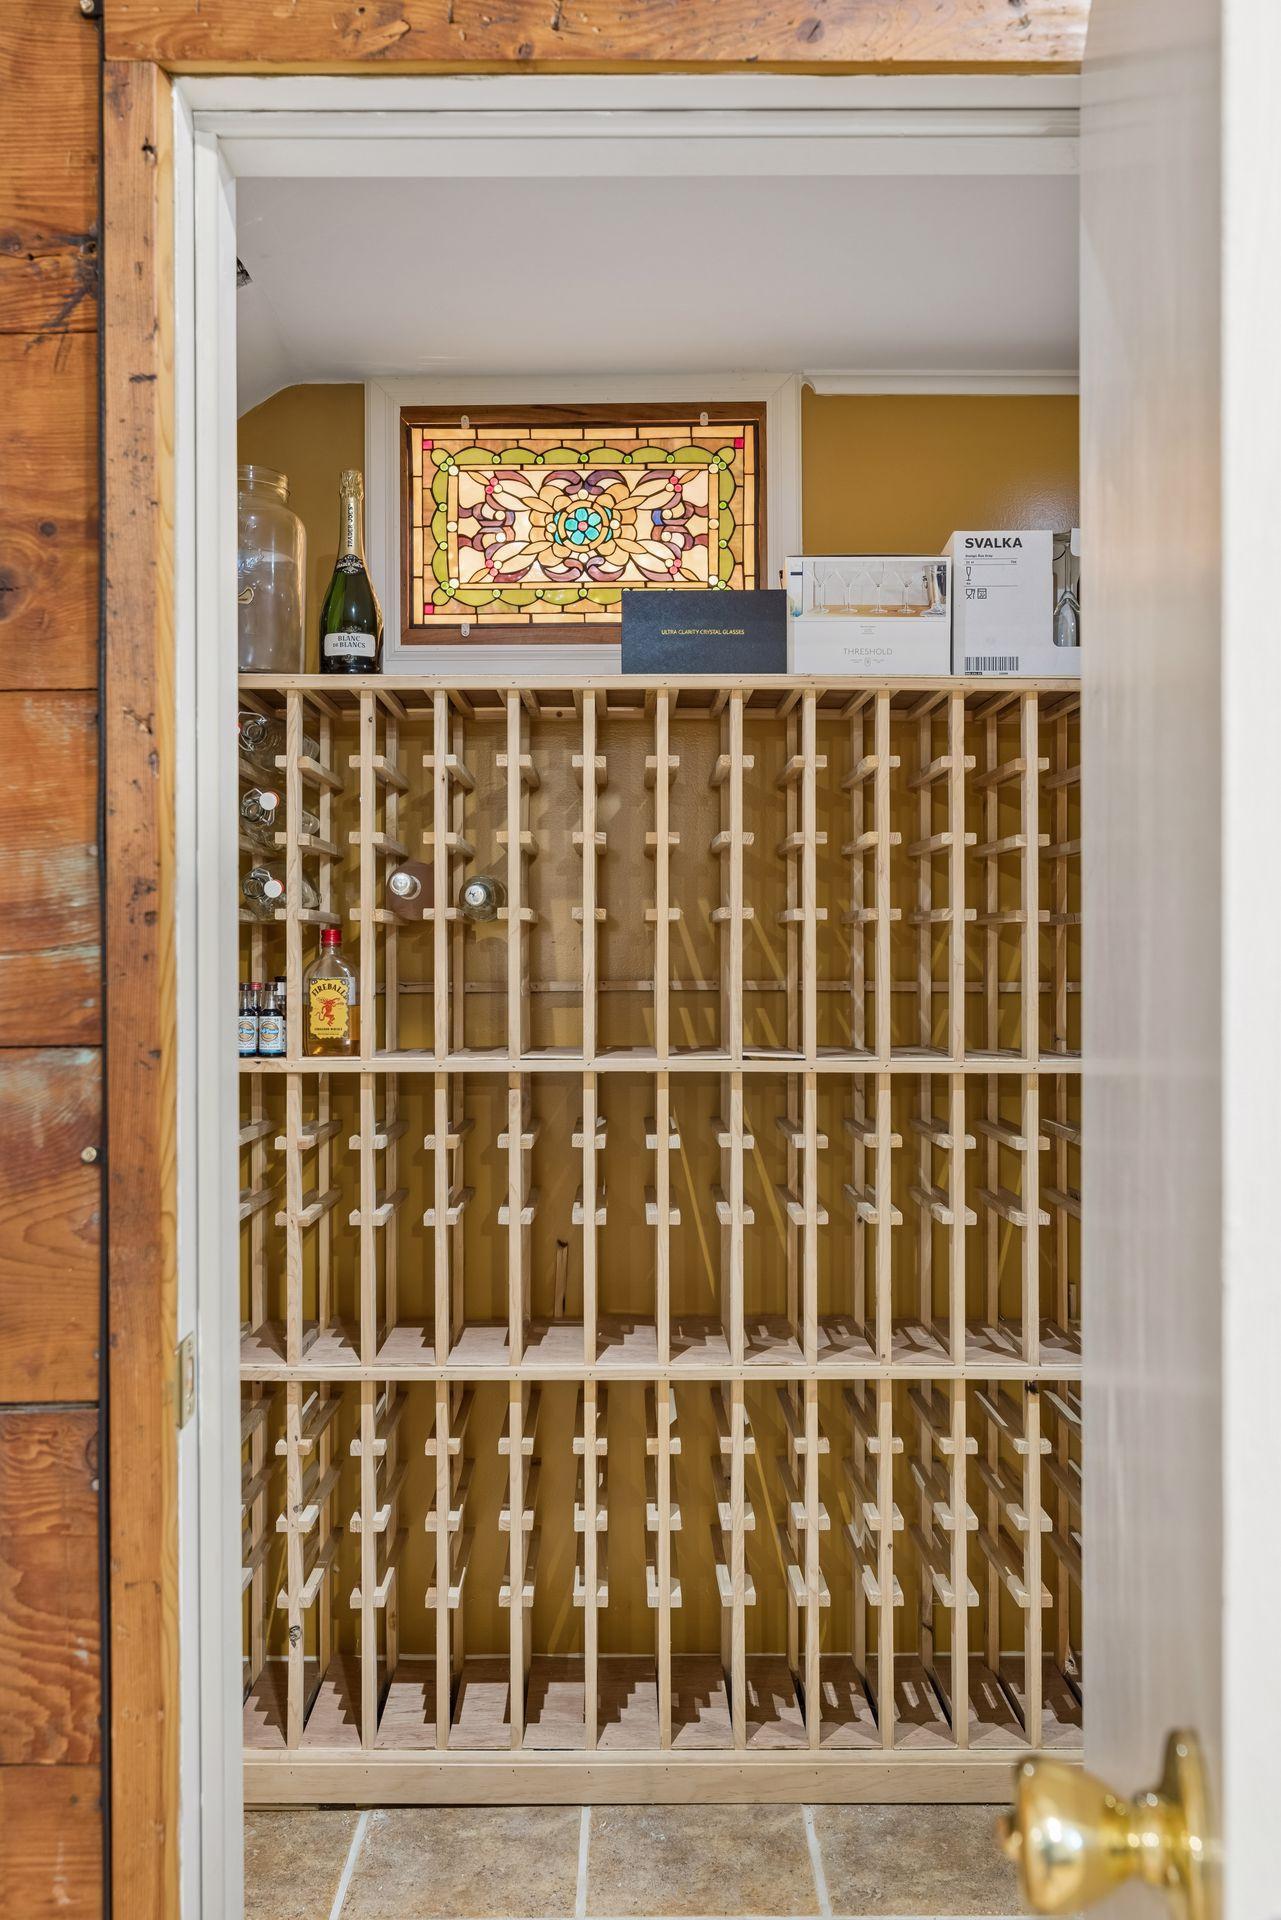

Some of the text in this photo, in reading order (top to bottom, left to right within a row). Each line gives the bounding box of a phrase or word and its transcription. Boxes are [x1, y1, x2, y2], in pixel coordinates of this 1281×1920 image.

[965, 537, 1023, 549] SVALKA
[843, 647, 893, 656] THRESHOLD
[311, 983, 347, 1000] FIREBALL
